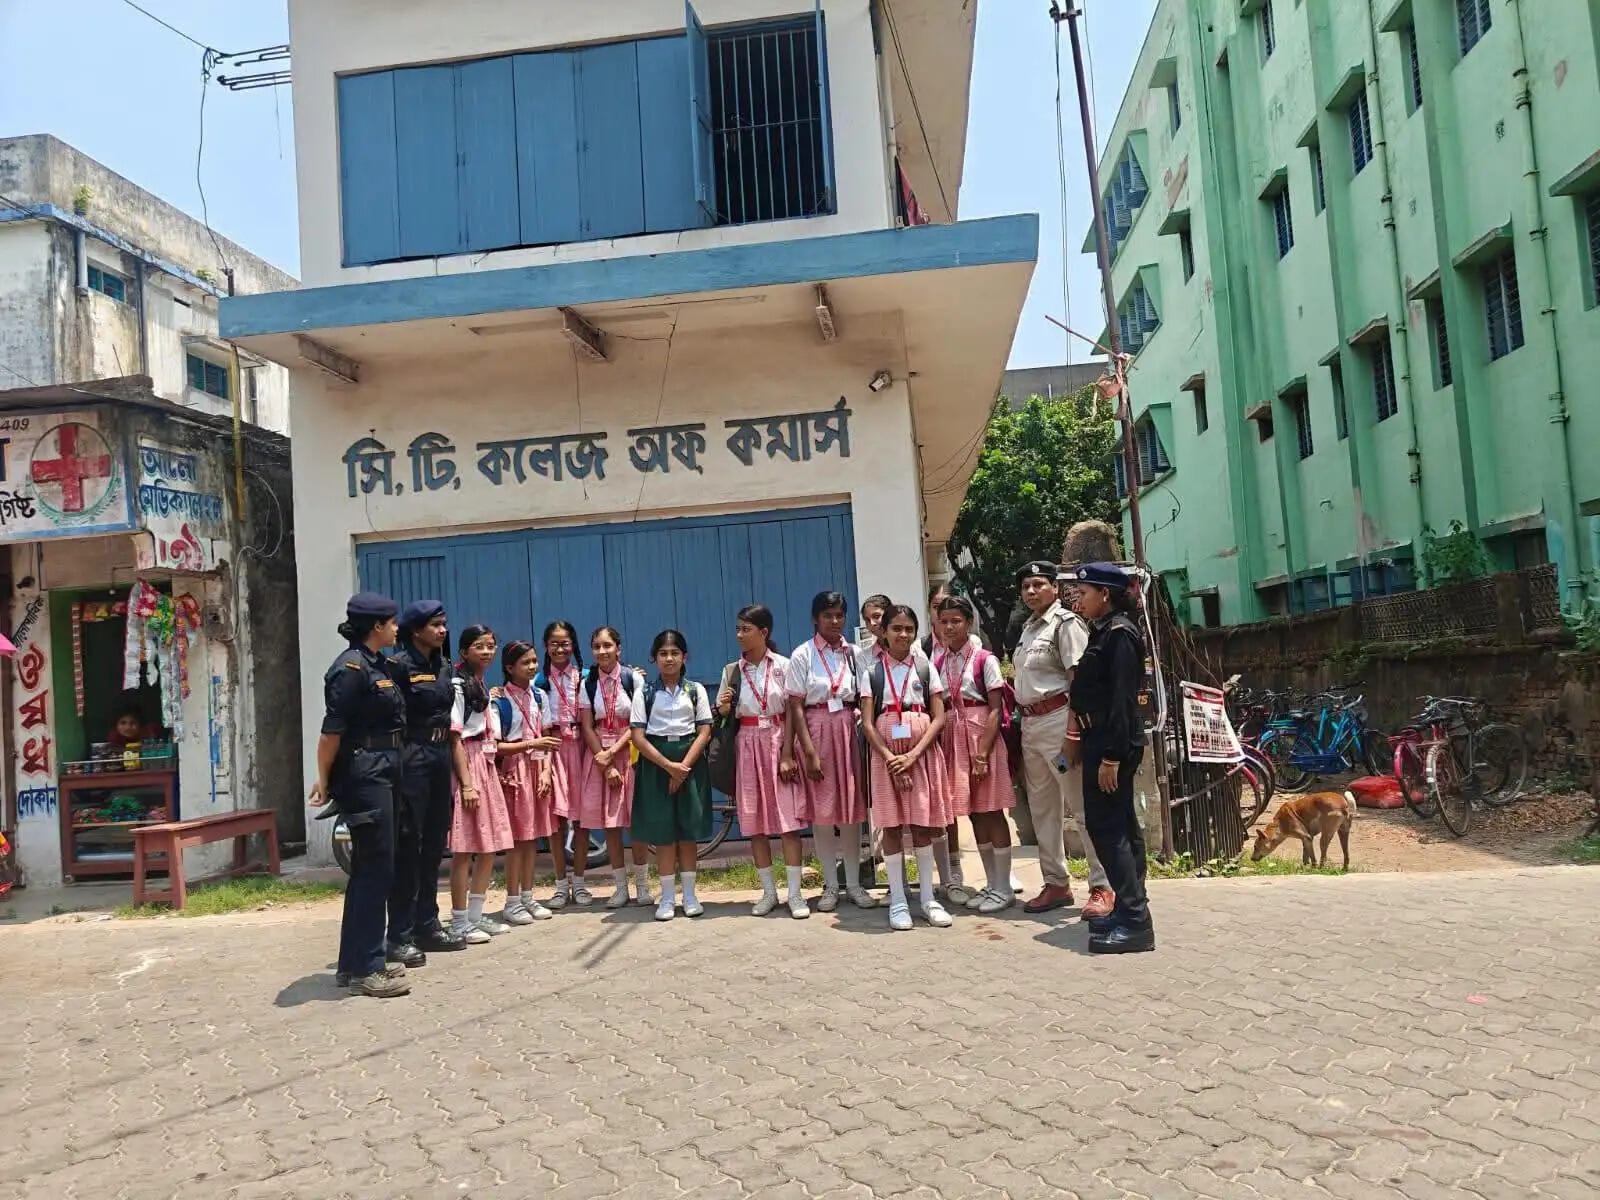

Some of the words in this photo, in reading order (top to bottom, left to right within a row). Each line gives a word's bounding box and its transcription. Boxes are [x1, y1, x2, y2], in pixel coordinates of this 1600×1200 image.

[476, 432, 609, 485] কলেজ
[724, 395, 852, 466] কমার্স
[17, 784, 58, 819] দোকান
